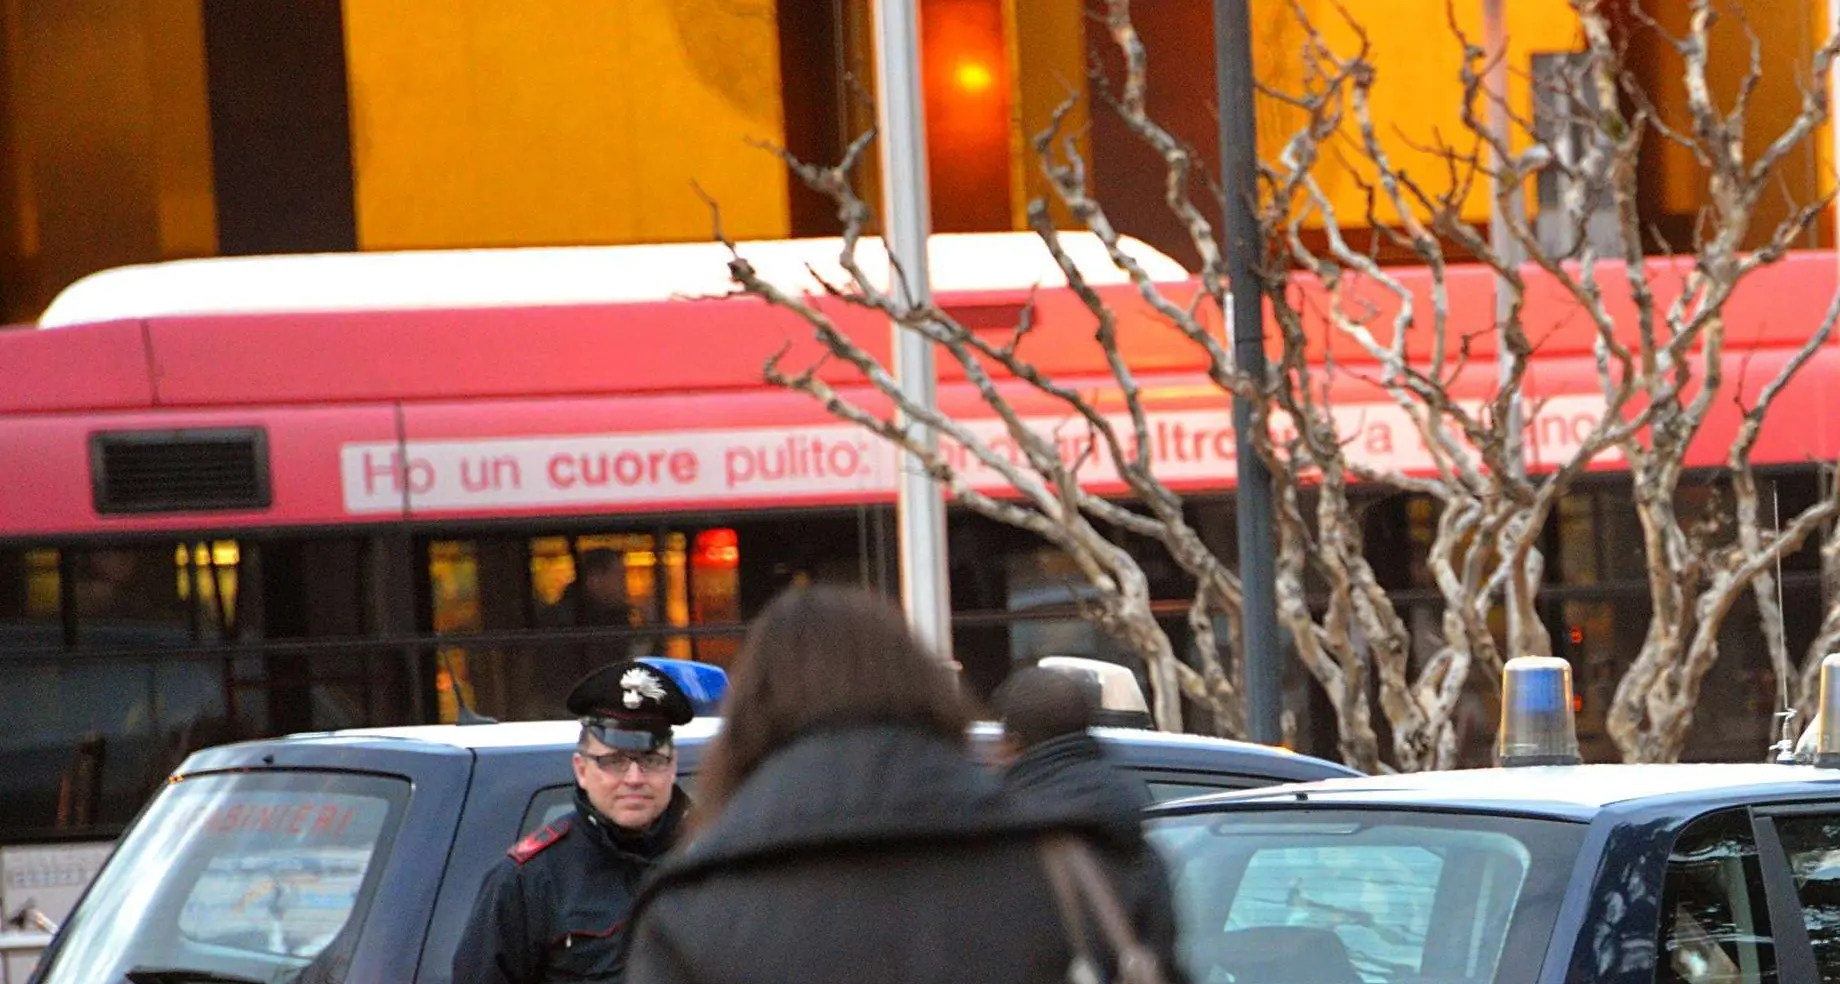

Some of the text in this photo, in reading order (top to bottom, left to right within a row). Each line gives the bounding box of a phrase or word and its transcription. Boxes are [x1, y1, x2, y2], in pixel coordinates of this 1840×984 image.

[363, 451, 436, 496] Ho
[460, 454, 522, 494] un
[547, 447, 699, 489] cuore
[724, 436, 869, 488] pulito:
